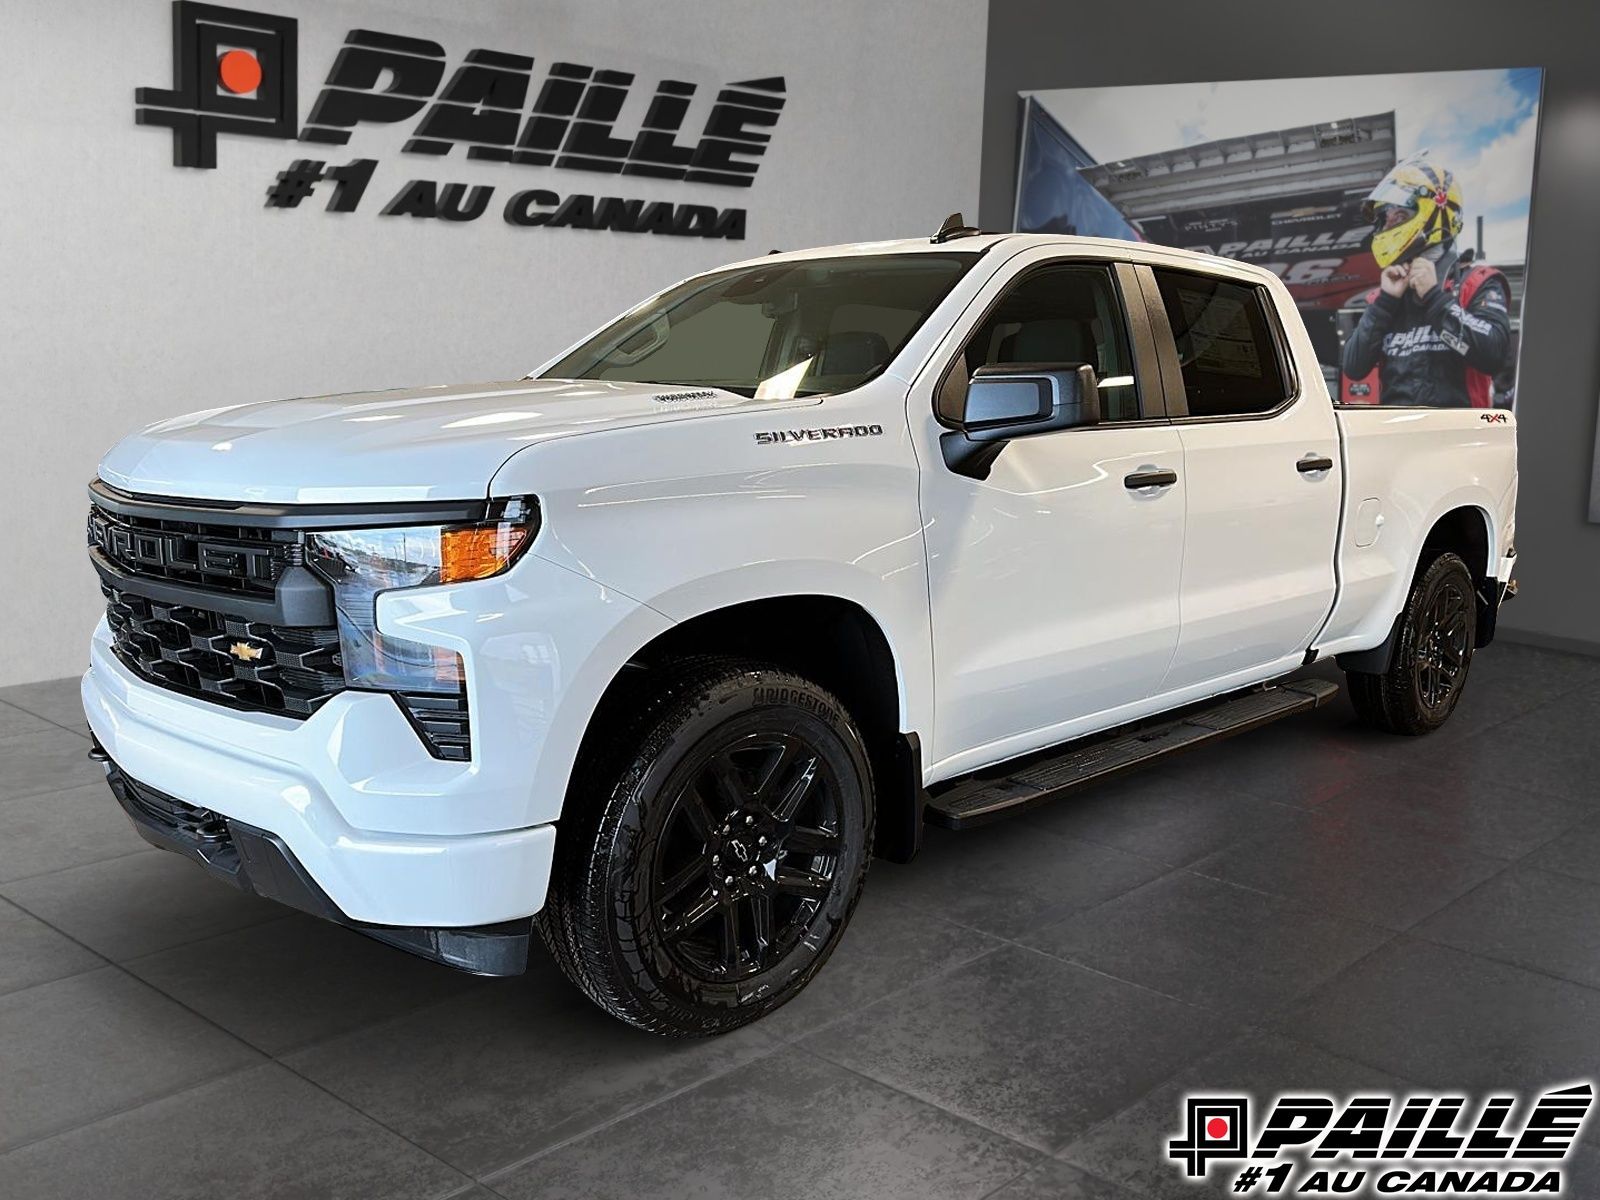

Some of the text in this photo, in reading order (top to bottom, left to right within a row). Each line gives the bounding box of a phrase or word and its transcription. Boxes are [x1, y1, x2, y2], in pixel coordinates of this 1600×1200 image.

[299, 28, 786, 188] PAILLÉ
[264, 158, 747, 240] #1 AU CANADA
[1274, 243, 1361, 255] CANADA
[755, 424, 883, 445] SILVERADO
[752, 686, 842, 725] BRIDGESTONE
